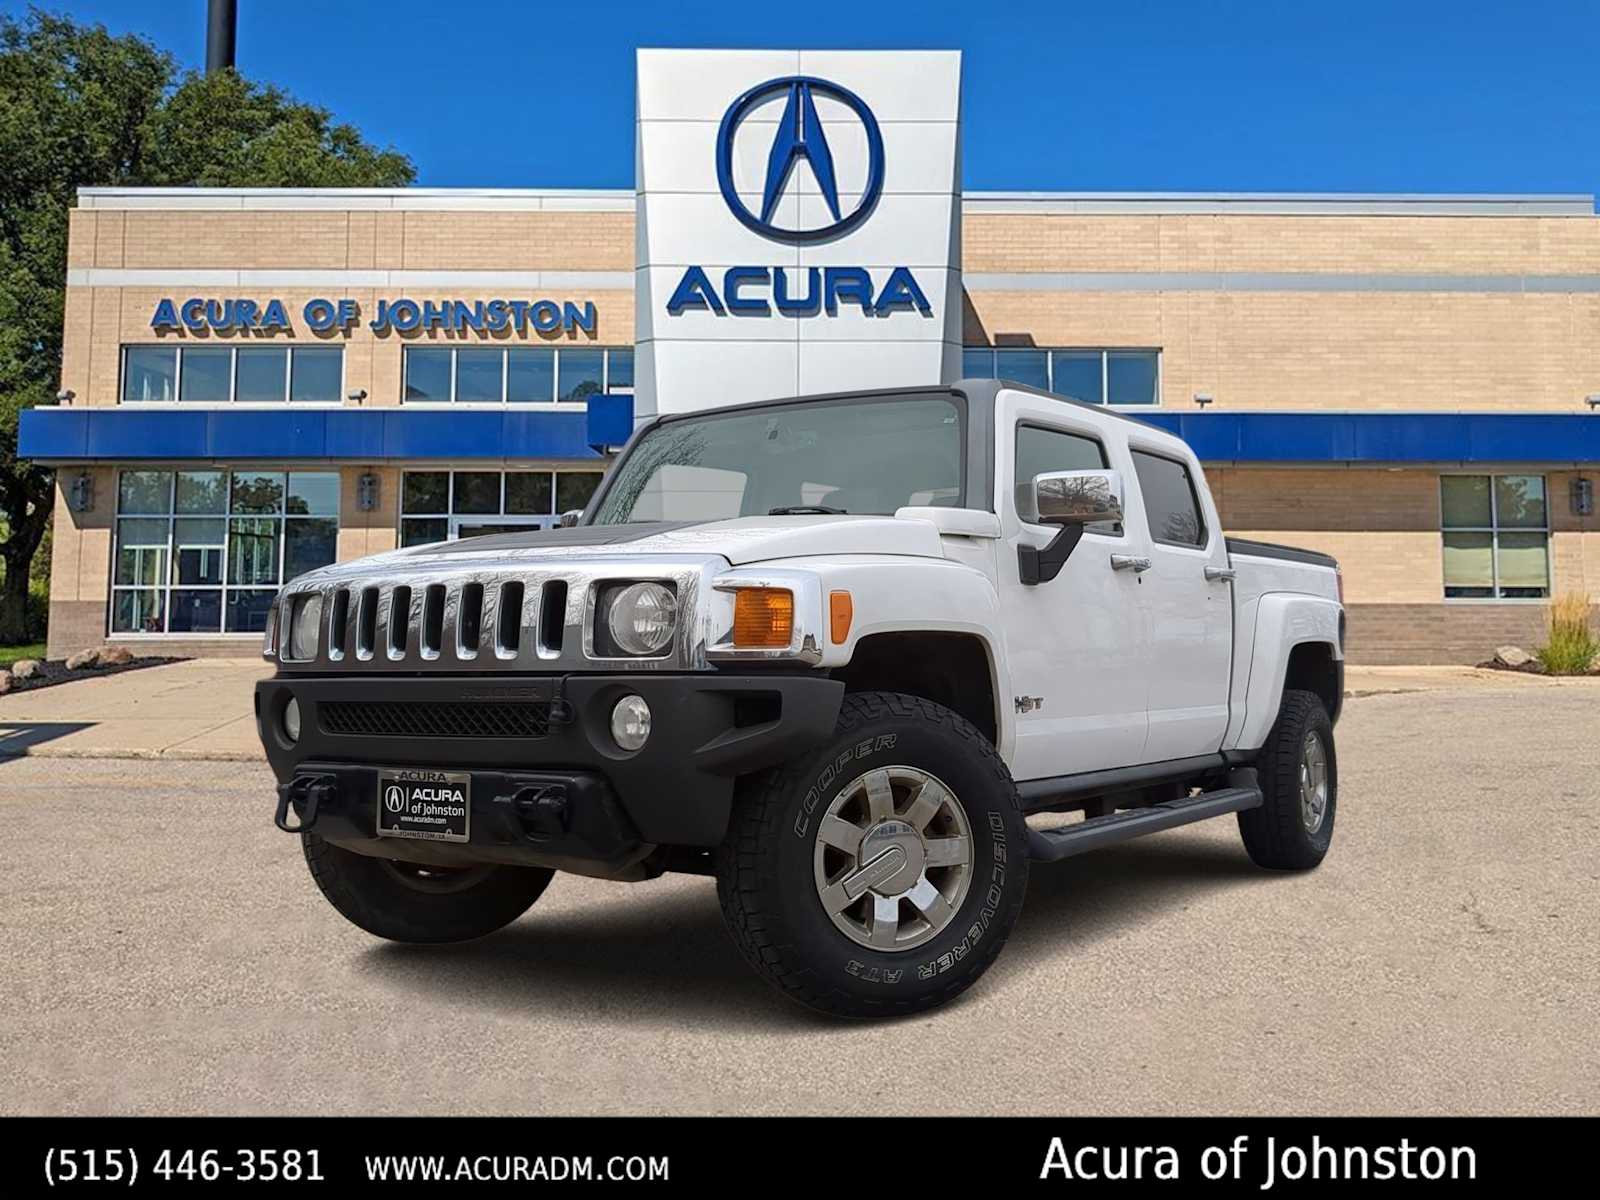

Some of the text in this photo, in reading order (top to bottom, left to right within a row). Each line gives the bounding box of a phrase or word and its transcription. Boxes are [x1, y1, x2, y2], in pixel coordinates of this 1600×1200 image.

[667, 265, 933, 317] ACURA
[151, 298, 596, 332] ACURA OF JOHNSTON
[399, 771, 447, 782] ACURA
[793, 733, 897, 839] COOPER
[411, 788, 465, 803] ACURA
[400, 815, 447, 825] www.acuradm.com
[411, 802, 465, 817] of Johnston
[844, 811, 1008, 984] DISCOVERER AT3
